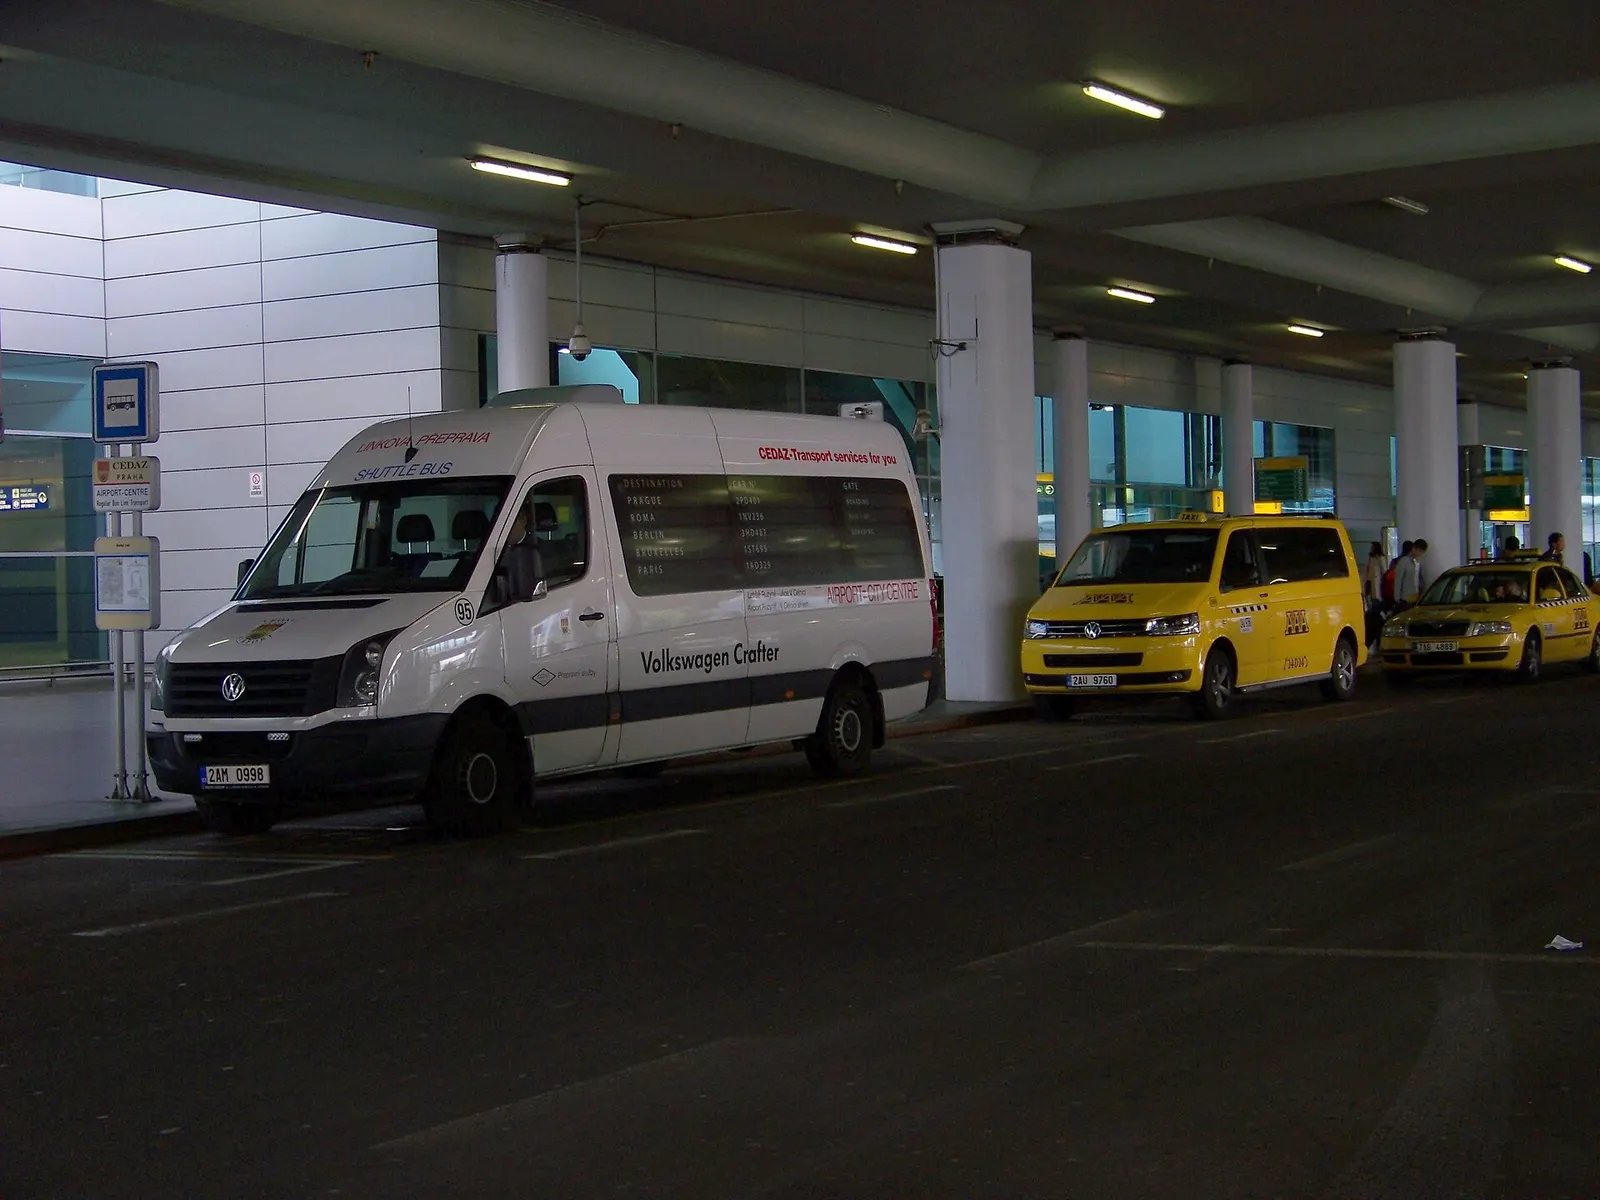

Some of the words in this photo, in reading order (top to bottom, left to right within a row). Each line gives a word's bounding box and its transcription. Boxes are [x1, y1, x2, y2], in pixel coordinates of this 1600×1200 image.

[833, 451, 868, 464] services
[869, 452, 881, 464] for
[882, 455, 897, 466] you
[112, 460, 149, 470] CEDAZ
[354, 464, 421, 481] SHUTTLE
[419, 462, 453, 475] BUS
[623, 479, 684, 488] DESTINATION
[627, 496, 662, 505] PRAGUE
[630, 514, 656, 522] ROMA
[1181, 513, 1200, 521] TAXI
[633, 531, 665, 540] BERLIN
[635, 548, 684, 557] BRUXELLES
[638, 565, 663, 574] PARIS
[886, 581, 919, 600] CENTRE
[457, 603, 473, 620] 95
[641, 648, 729, 674] Volkswagen
[733, 640, 779, 665] Crafter
[1073, 676, 1088, 685] 2AU
[1093, 676, 1113, 685] 9760
[208, 768, 229, 783] 2AM
[236, 768, 264, 782] 0998
